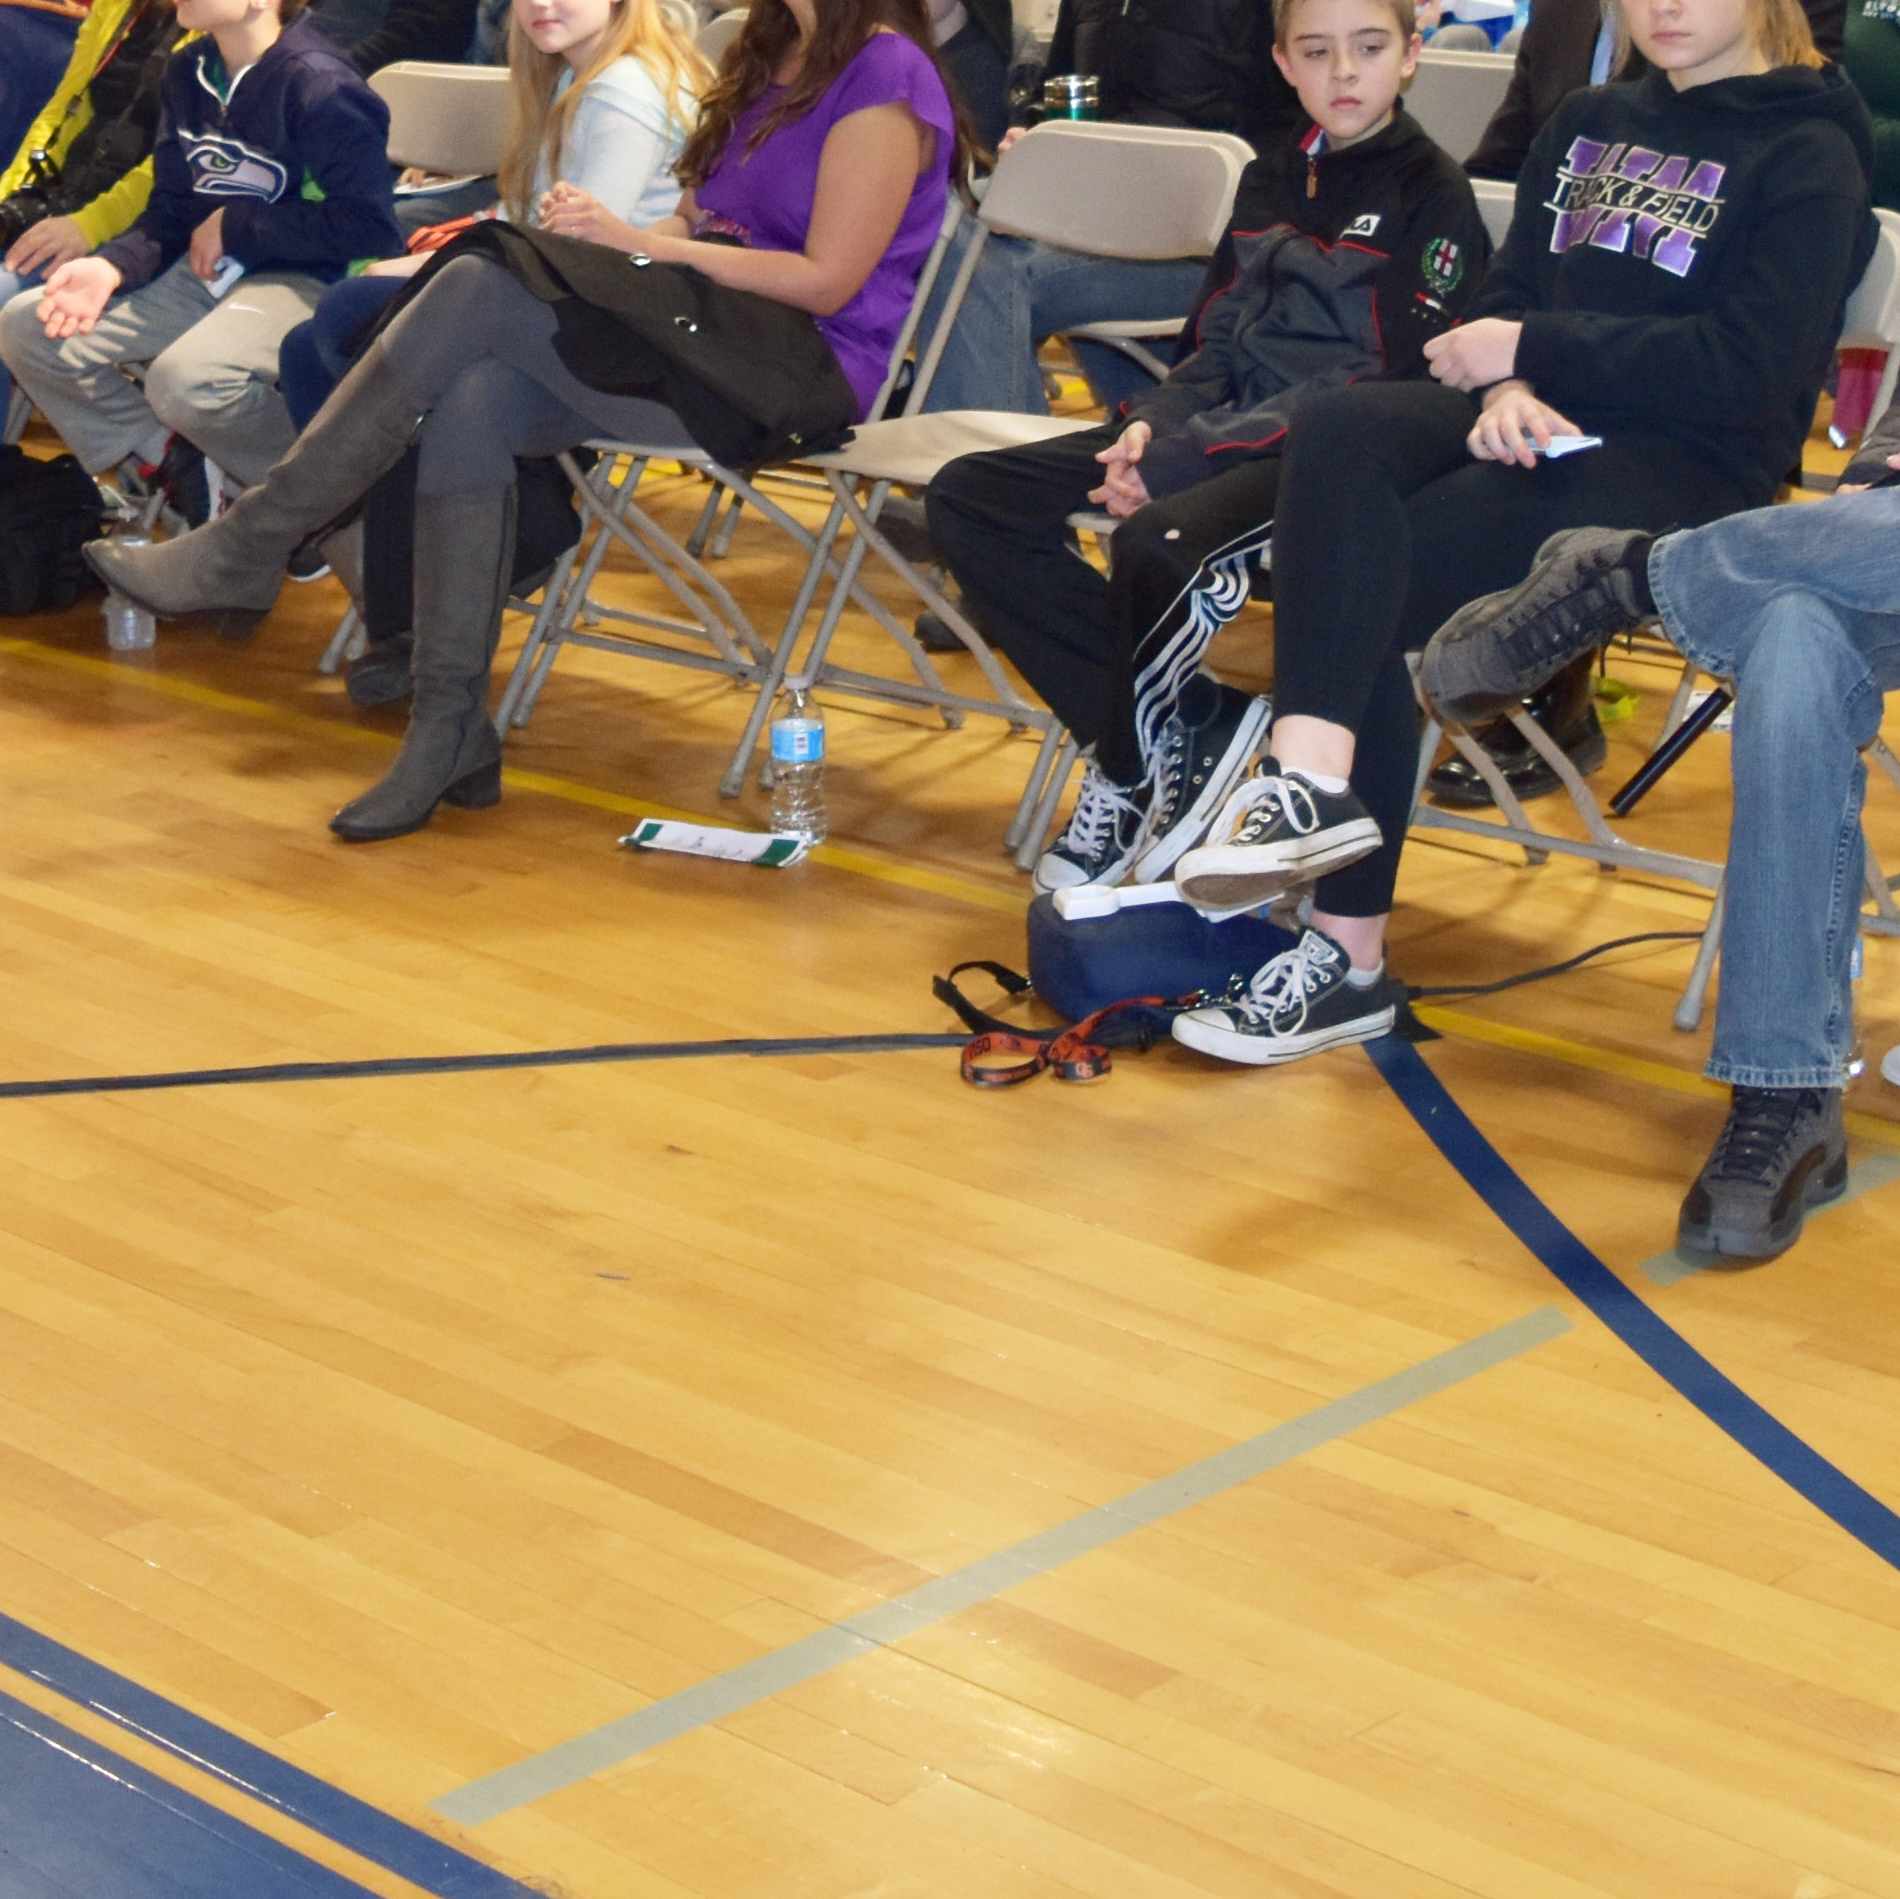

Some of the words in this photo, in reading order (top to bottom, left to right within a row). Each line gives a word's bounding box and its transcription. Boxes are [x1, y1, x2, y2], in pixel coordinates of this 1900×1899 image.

[1555, 172, 1625, 209] TRACK
[1618, 184, 1644, 207] &
[1640, 191, 1720, 232] FIELD
